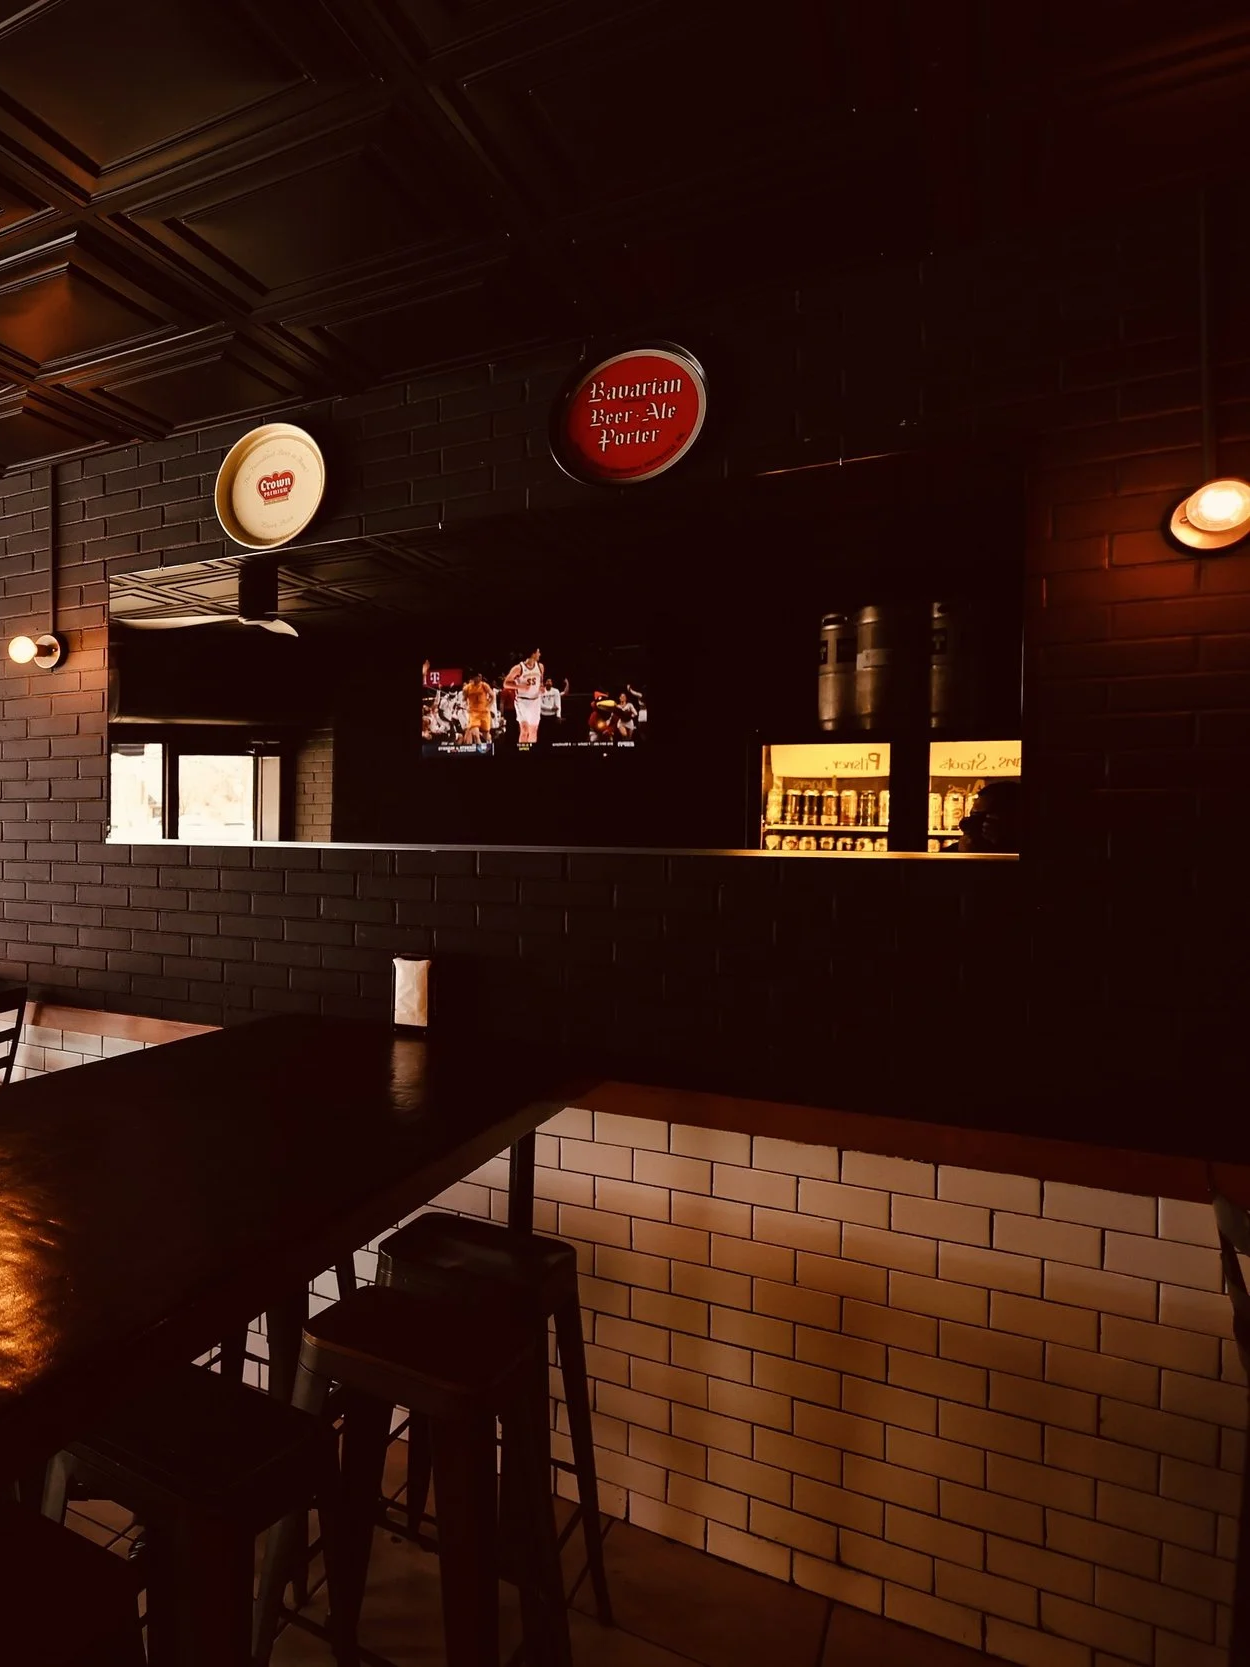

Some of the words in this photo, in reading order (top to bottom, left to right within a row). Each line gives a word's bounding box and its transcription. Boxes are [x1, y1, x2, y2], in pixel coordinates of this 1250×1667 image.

[588, 377, 682, 403] Bavarian
[590, 409, 633, 427] Beer
[642, 402, 677, 422] Ale
[598, 428, 661, 453] Porter
[260, 478, 291, 492] Crown
